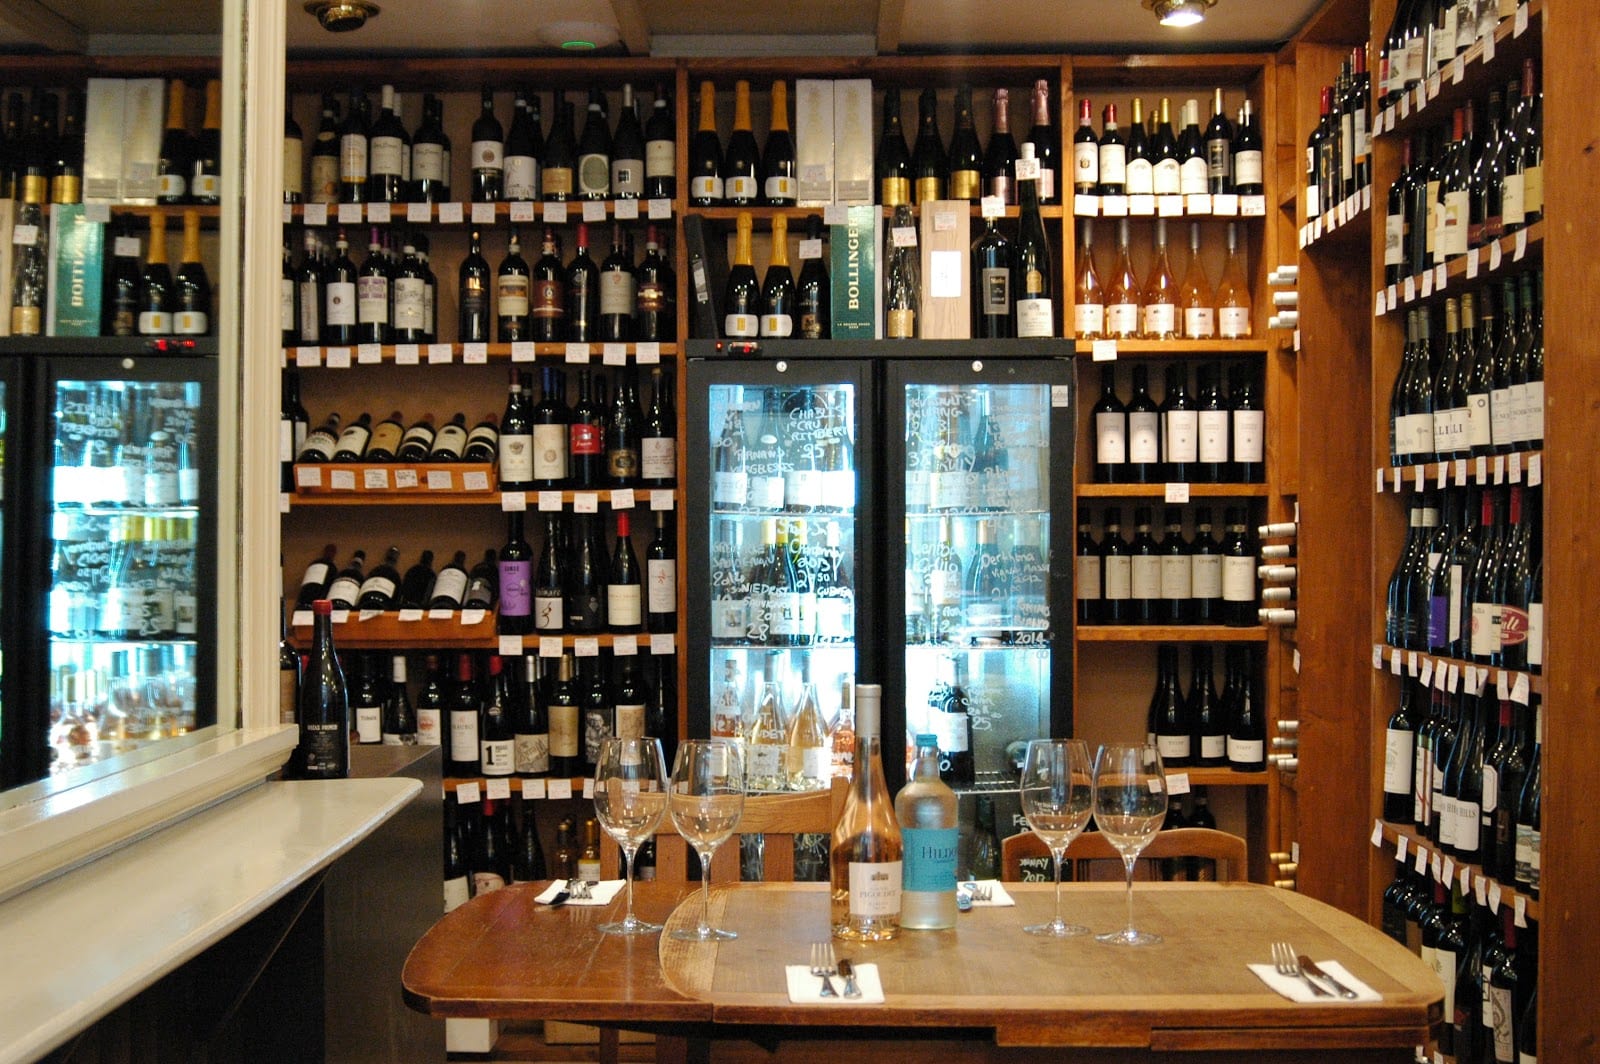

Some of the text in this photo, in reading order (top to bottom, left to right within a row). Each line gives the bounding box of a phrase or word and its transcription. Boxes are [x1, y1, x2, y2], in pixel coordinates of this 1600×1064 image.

[848, 217, 860, 310] BOLLINGER
[1015, 631, 1047, 645] 2014
[485, 745, 495, 765] 1
